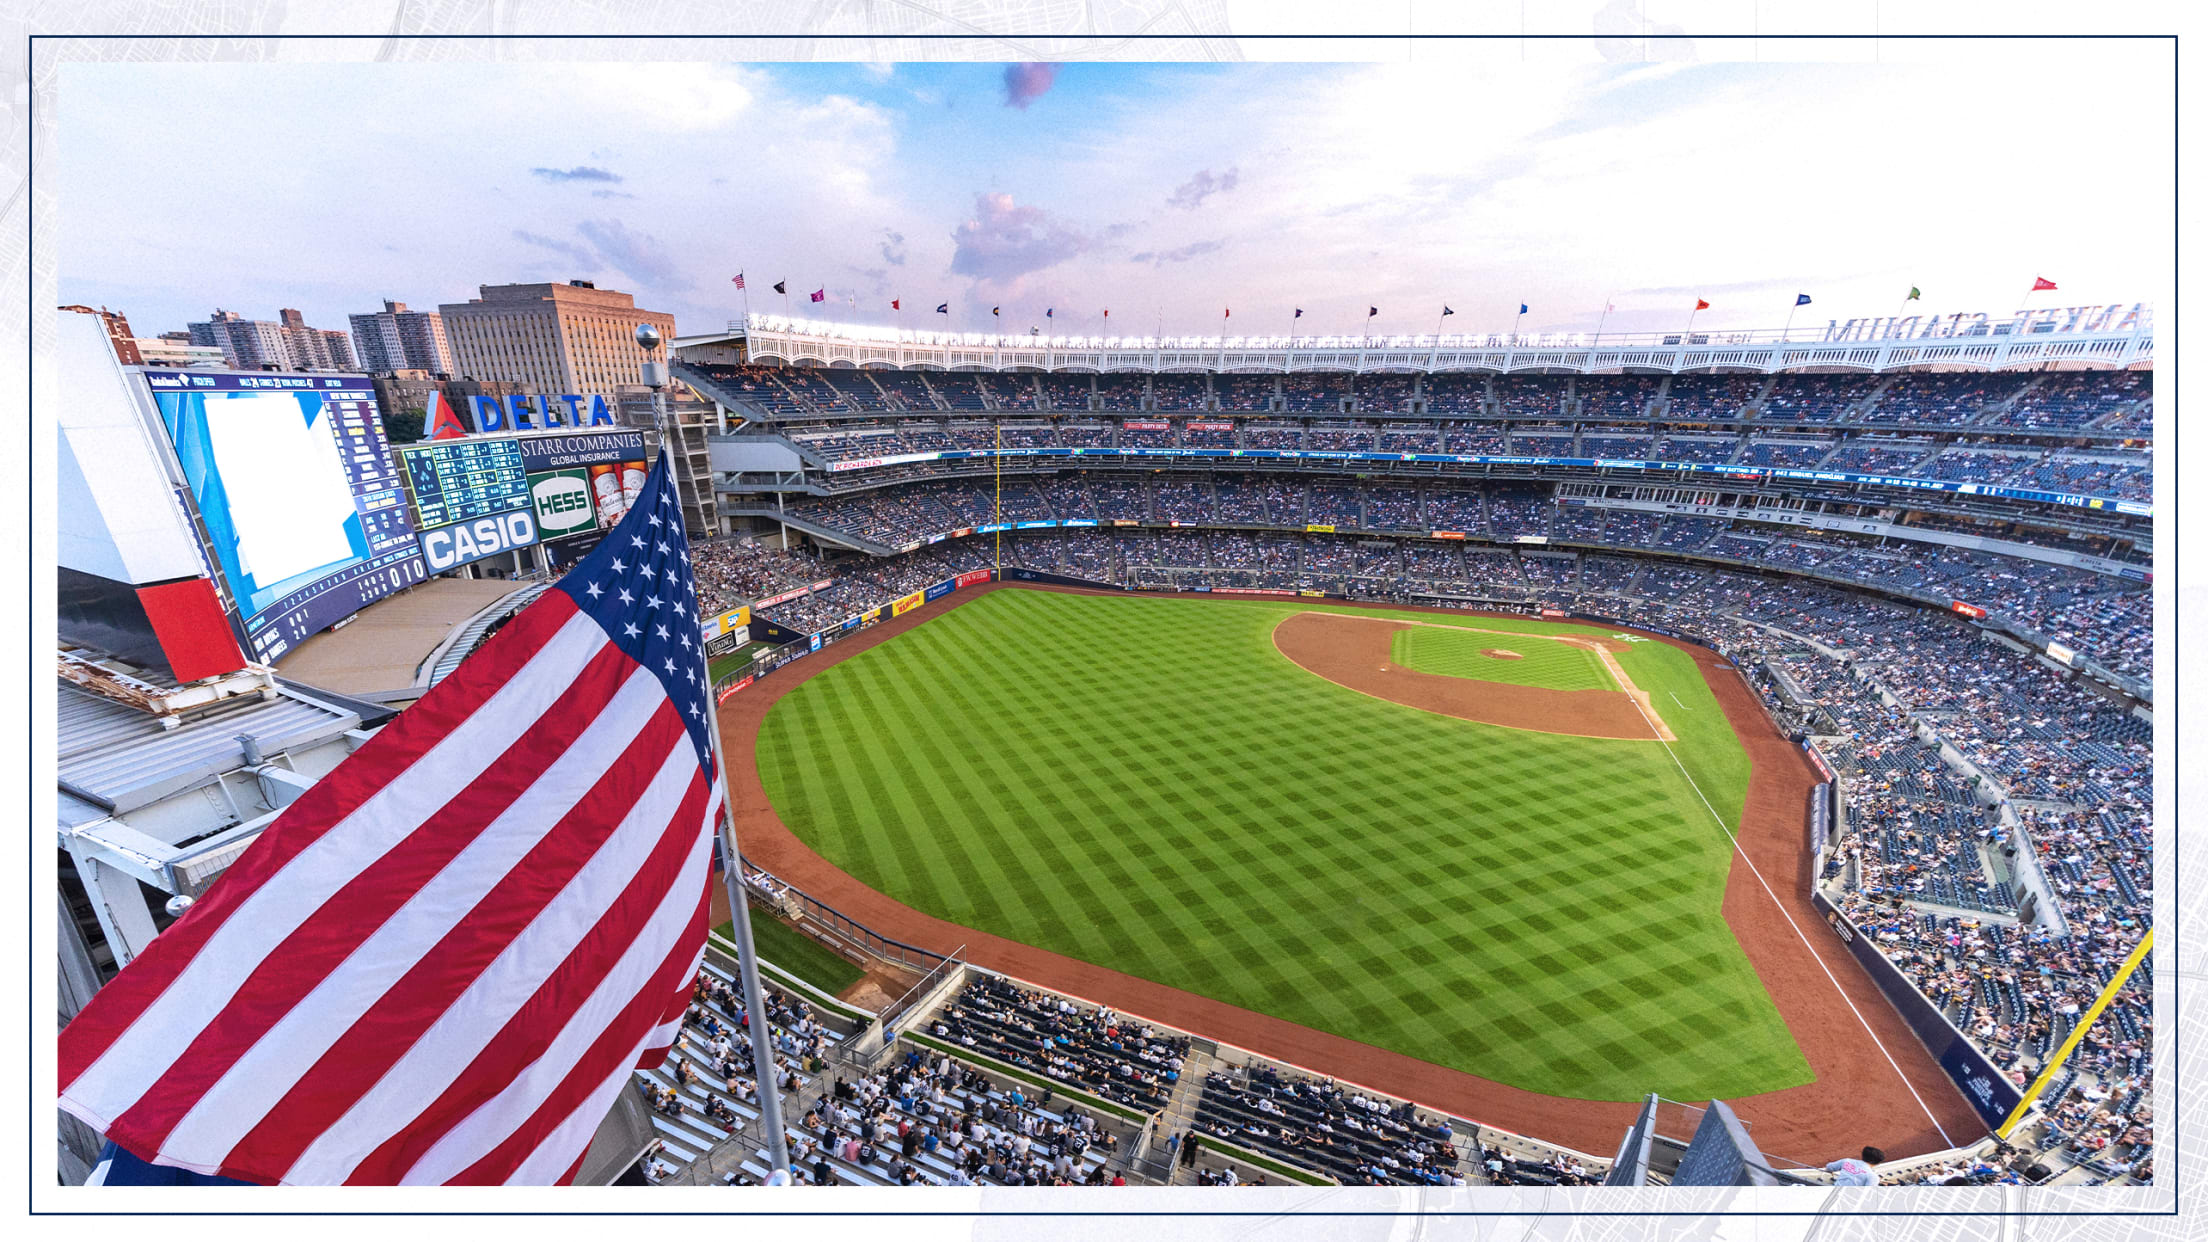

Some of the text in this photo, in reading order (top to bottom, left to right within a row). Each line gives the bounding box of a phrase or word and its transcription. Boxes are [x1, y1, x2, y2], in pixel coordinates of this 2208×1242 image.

[469, 395, 614, 433] DELTA
[521, 433, 643, 457] STARR COMPANIES
[406, 449, 432, 459] TEX HOU
[550, 451, 620, 466] GLOBAL INSURANCE
[410, 460, 432, 473] 1 0
[537, 490, 587, 516] HESS
[1852, 496, 1886, 505] Champions
[424, 511, 534, 569] CASIO
[389, 559, 424, 588] 0 1 0
[971, 571, 988, 579] WEBB
[728, 614, 738, 626] SAP
[710, 635, 733, 653] VIKING
